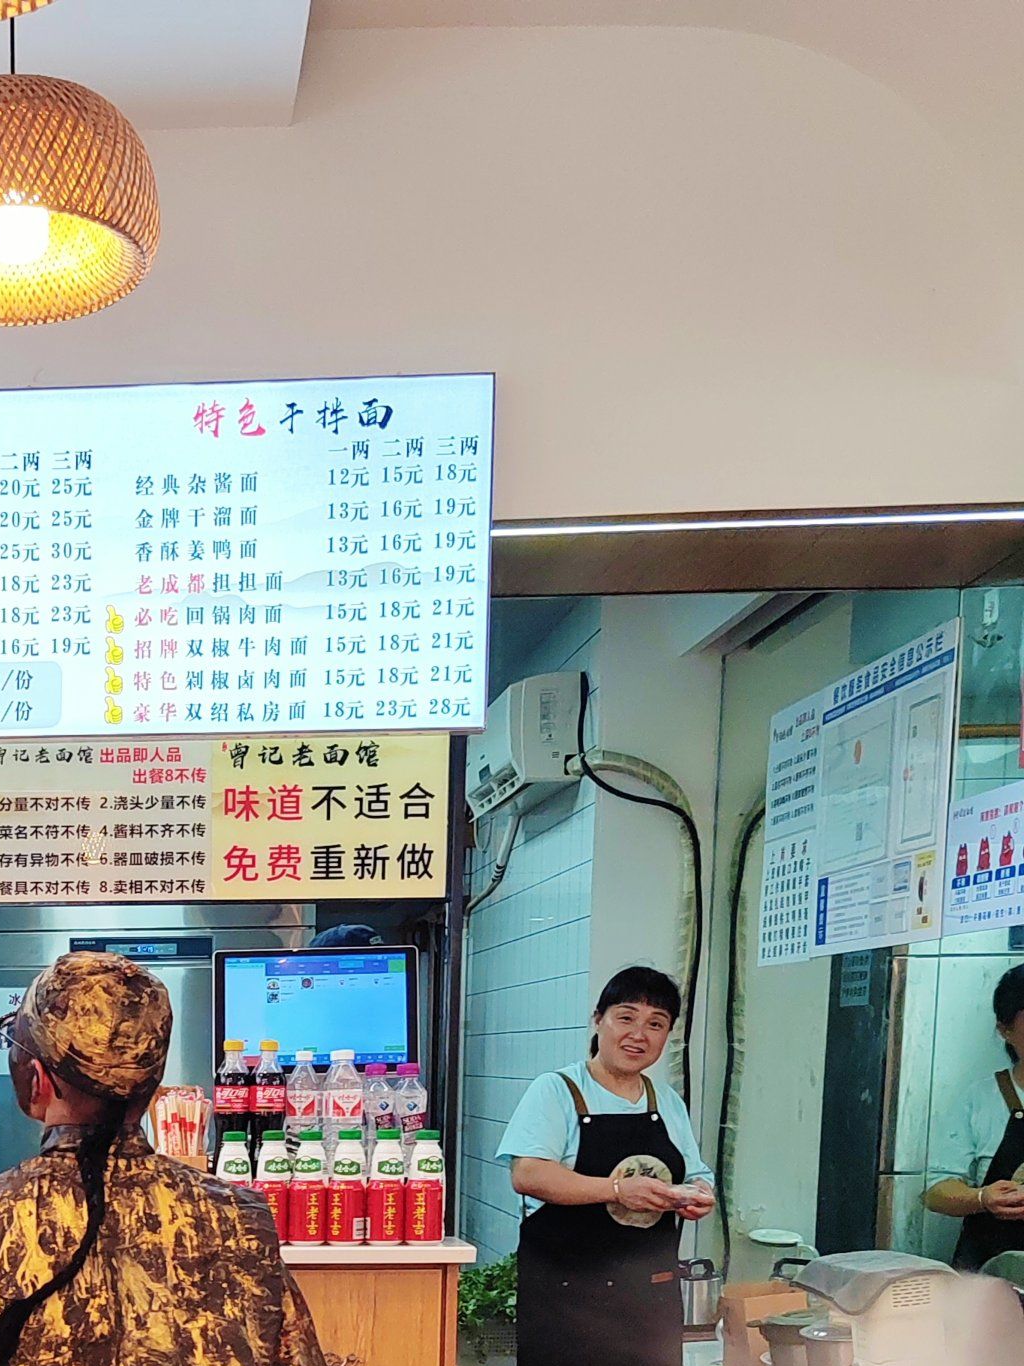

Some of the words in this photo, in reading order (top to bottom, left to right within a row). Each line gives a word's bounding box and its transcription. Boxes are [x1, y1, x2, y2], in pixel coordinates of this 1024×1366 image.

[193, 397, 393, 437] 特色干拌面
[329, 439, 370, 460] 一两
[383, 436, 424, 458] 二两
[437, 435, 479, 456] 三两
[1, 451, 40, 472] 二两
[53, 449, 93, 470] 三两
[0, 478, 40, 498] 20元
[52, 477, 92, 497] 25元
[136, 472, 258, 495] 经典杂酱面
[329, 467, 369, 488] 12元
[382, 464, 423, 485] 15元
[436, 463, 477, 483] 18元
[0, 511, 40, 531] 20元
[52, 509, 92, 529] 25元
[136, 505, 257, 528] 金牌干溜面
[328, 501, 368, 522] 13元
[382, 499, 422, 519] 16元
[435, 497, 476, 517] 19元
[0, 543, 40, 562] 25元
[52, 541, 92, 560] 30元
[136, 538, 257, 562] 香酥姜鸭面
[328, 534, 368, 555] 13元
[381, 533, 422, 553] 16元
[435, 530, 476, 551] 19元
[1, 575, 40, 594] 18元
[52, 573, 92, 592] 23元
[136, 571, 283, 594] 老成都担担面
[327, 568, 368, 589] 13元
[380, 566, 421, 586] 16元
[434, 563, 475, 584] 19元
[1, 606, 39, 625] 18元
[51, 605, 92, 624] 23元
[135, 604, 283, 625] 必吃回锅肉面
[327, 602, 367, 622] 15元
[380, 600, 420, 620] 18元
[432, 597, 474, 617] 21元
[1, 638, 39, 657] 16元
[52, 637, 92, 656] 19元
[135, 635, 308, 659] 招牌双椒牛肉面
[326, 635, 366, 655] 15元
[379, 633, 419, 653] 18元
[432, 631, 473, 651] 21元
[134, 668, 307, 690] 特色剁椒卤肉面
[325, 668, 365, 687] 15元
[378, 666, 418, 685] 18元
[431, 664, 472, 683] 21元
[134, 700, 306, 722] 豪华双绍私房面
[324, 701, 364, 720] 18元
[376, 699, 417, 719] 23元
[429, 697, 471, 717] 28元
[100, 747, 182, 763] 出品即人品
[229, 741, 381, 770] 曾记老面馆
[132, 768, 207, 784] 出餐8不传
[99, 795, 207, 810] 2.浇头少量不传
[224, 782, 435, 822] 味道不适合
[99, 823, 207, 838] 4.酱料不齐不传
[99, 851, 206, 866] 6.器皿破损不传
[223, 843, 434, 882] 免费重新做
[99, 879, 206, 895] 8.卖相不对不传
[306, 1192, 320, 1236] 王老吉
[330, 1192, 342, 1236] 王老吉
[383, 1191, 396, 1236] 王老吉
[412, 1190, 426, 1235] 王老吉
